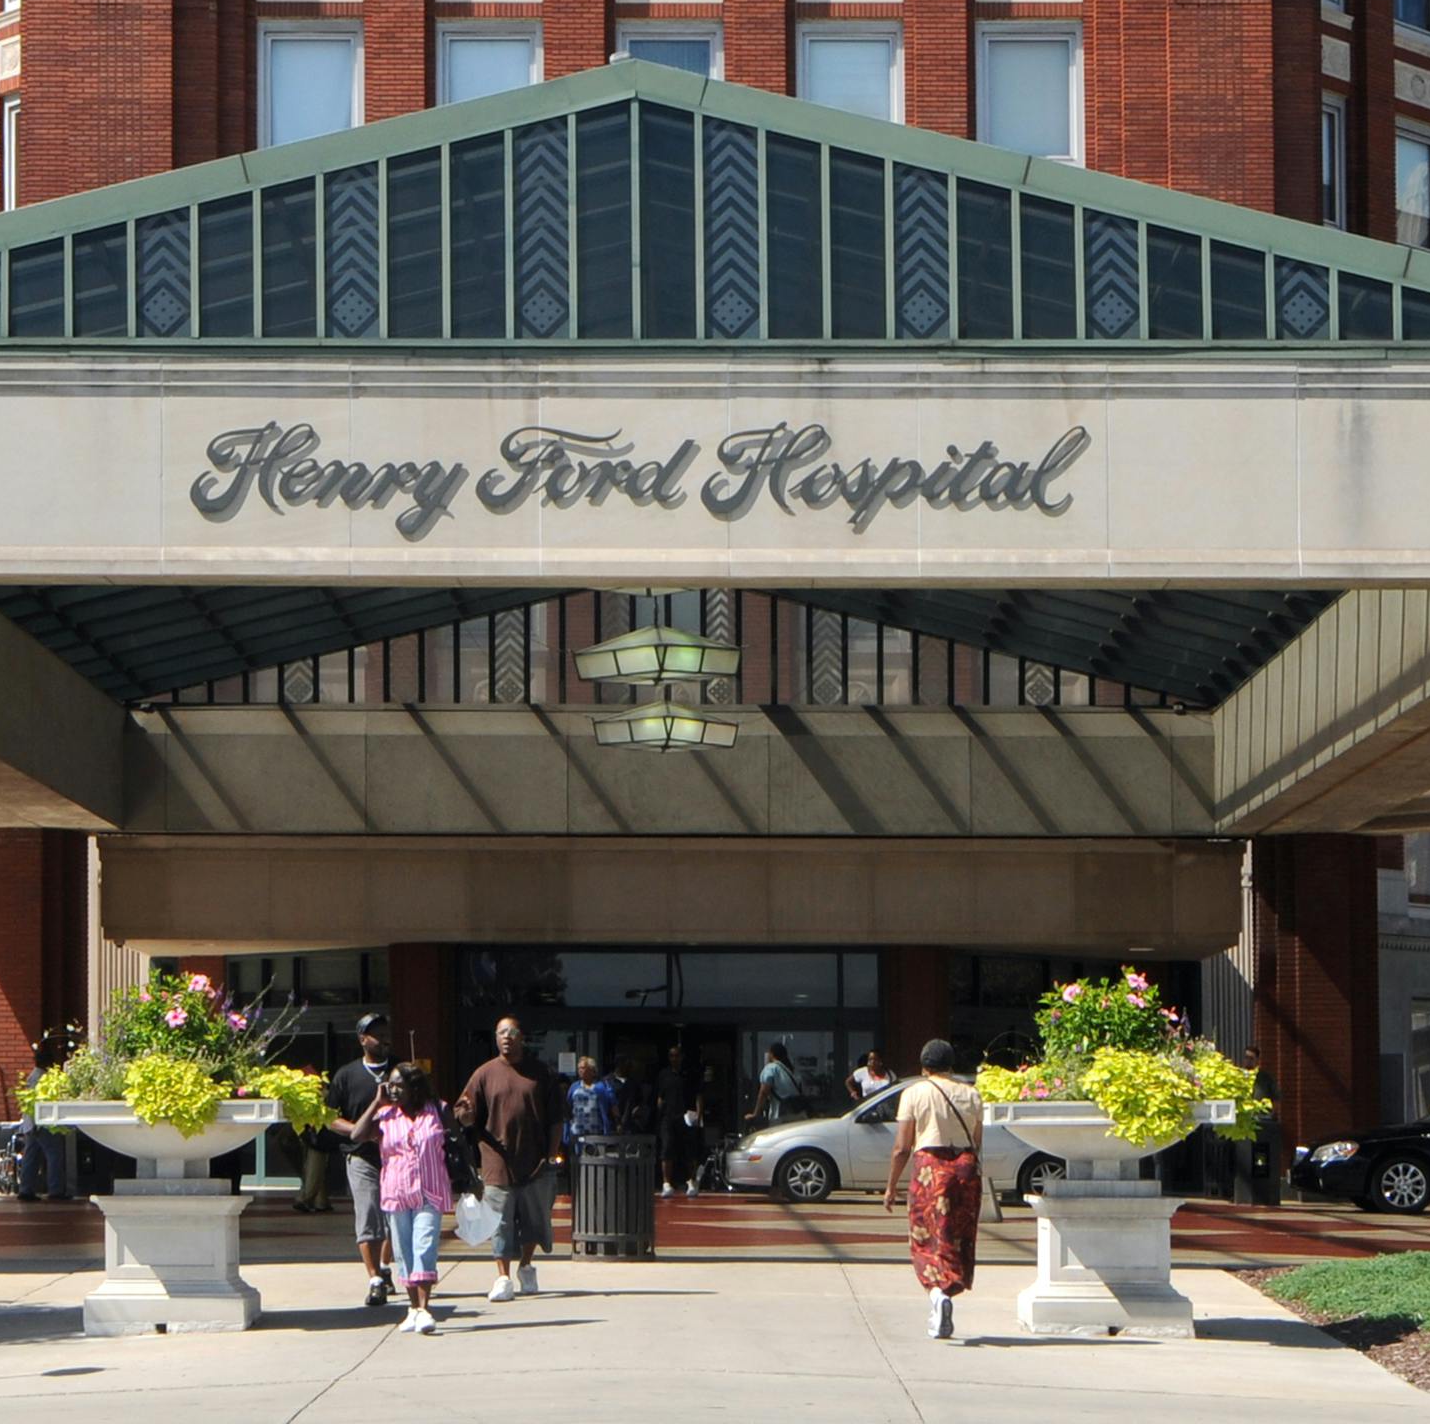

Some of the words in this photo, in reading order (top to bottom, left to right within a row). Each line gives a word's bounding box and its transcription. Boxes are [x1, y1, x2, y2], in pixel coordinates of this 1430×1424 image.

[190, 420, 468, 541] Henry
[475, 426, 699, 515] Ford
[700, 421, 1093, 535] Hospital
